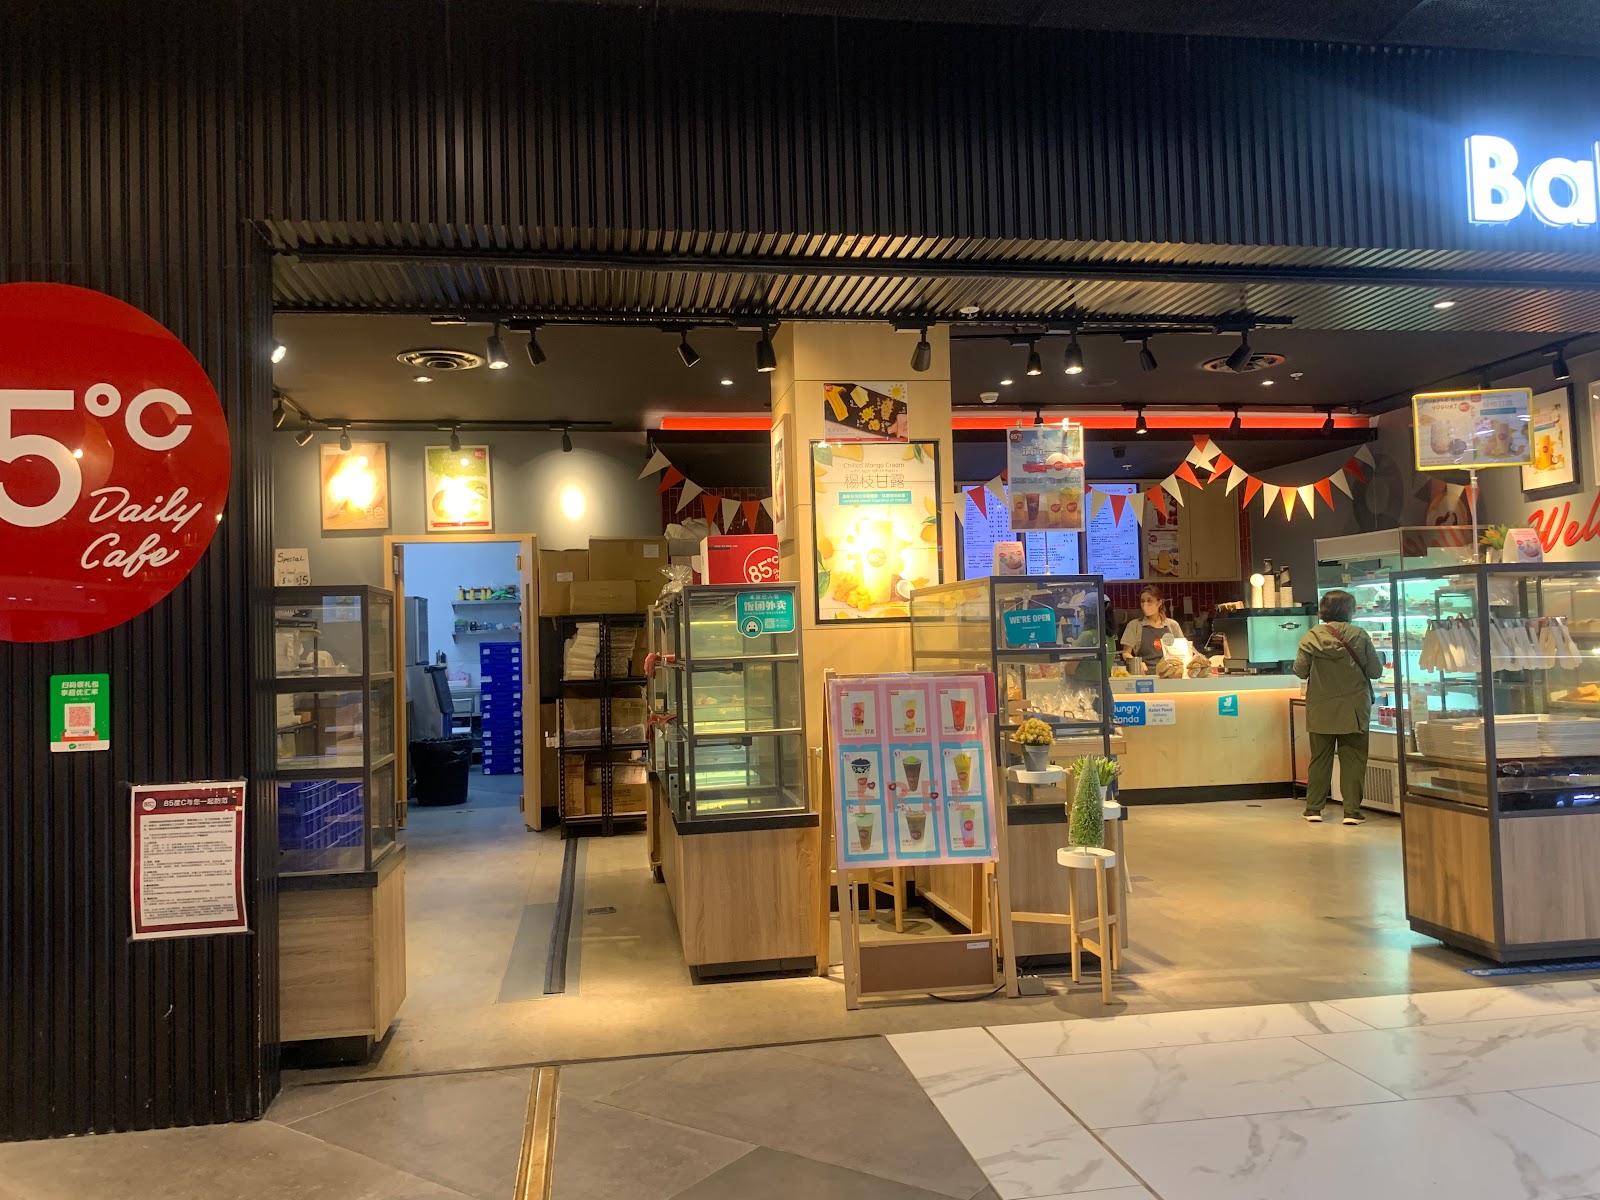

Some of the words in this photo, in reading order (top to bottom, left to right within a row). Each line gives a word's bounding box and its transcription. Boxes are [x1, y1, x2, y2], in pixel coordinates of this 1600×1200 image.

[1465, 134, 1600, 227] Ba
[864, 462, 885, 470] Mango
[843, 473, 905, 489] 楊枝甘露
[88, 486, 202, 534] Daily
[1527, 491, 1600, 554] Wel
[80, 532, 180, 578] Cafe
[277, 552, 305, 564] Special
[744, 600, 787, 611] 饭团外卖
[1009, 615, 1031, 624] WE'RE
[1032, 613, 1051, 622] OPEN
[61, 680, 99, 689] 扫码领礼包
[61, 688, 99, 697] 享超优汇率
